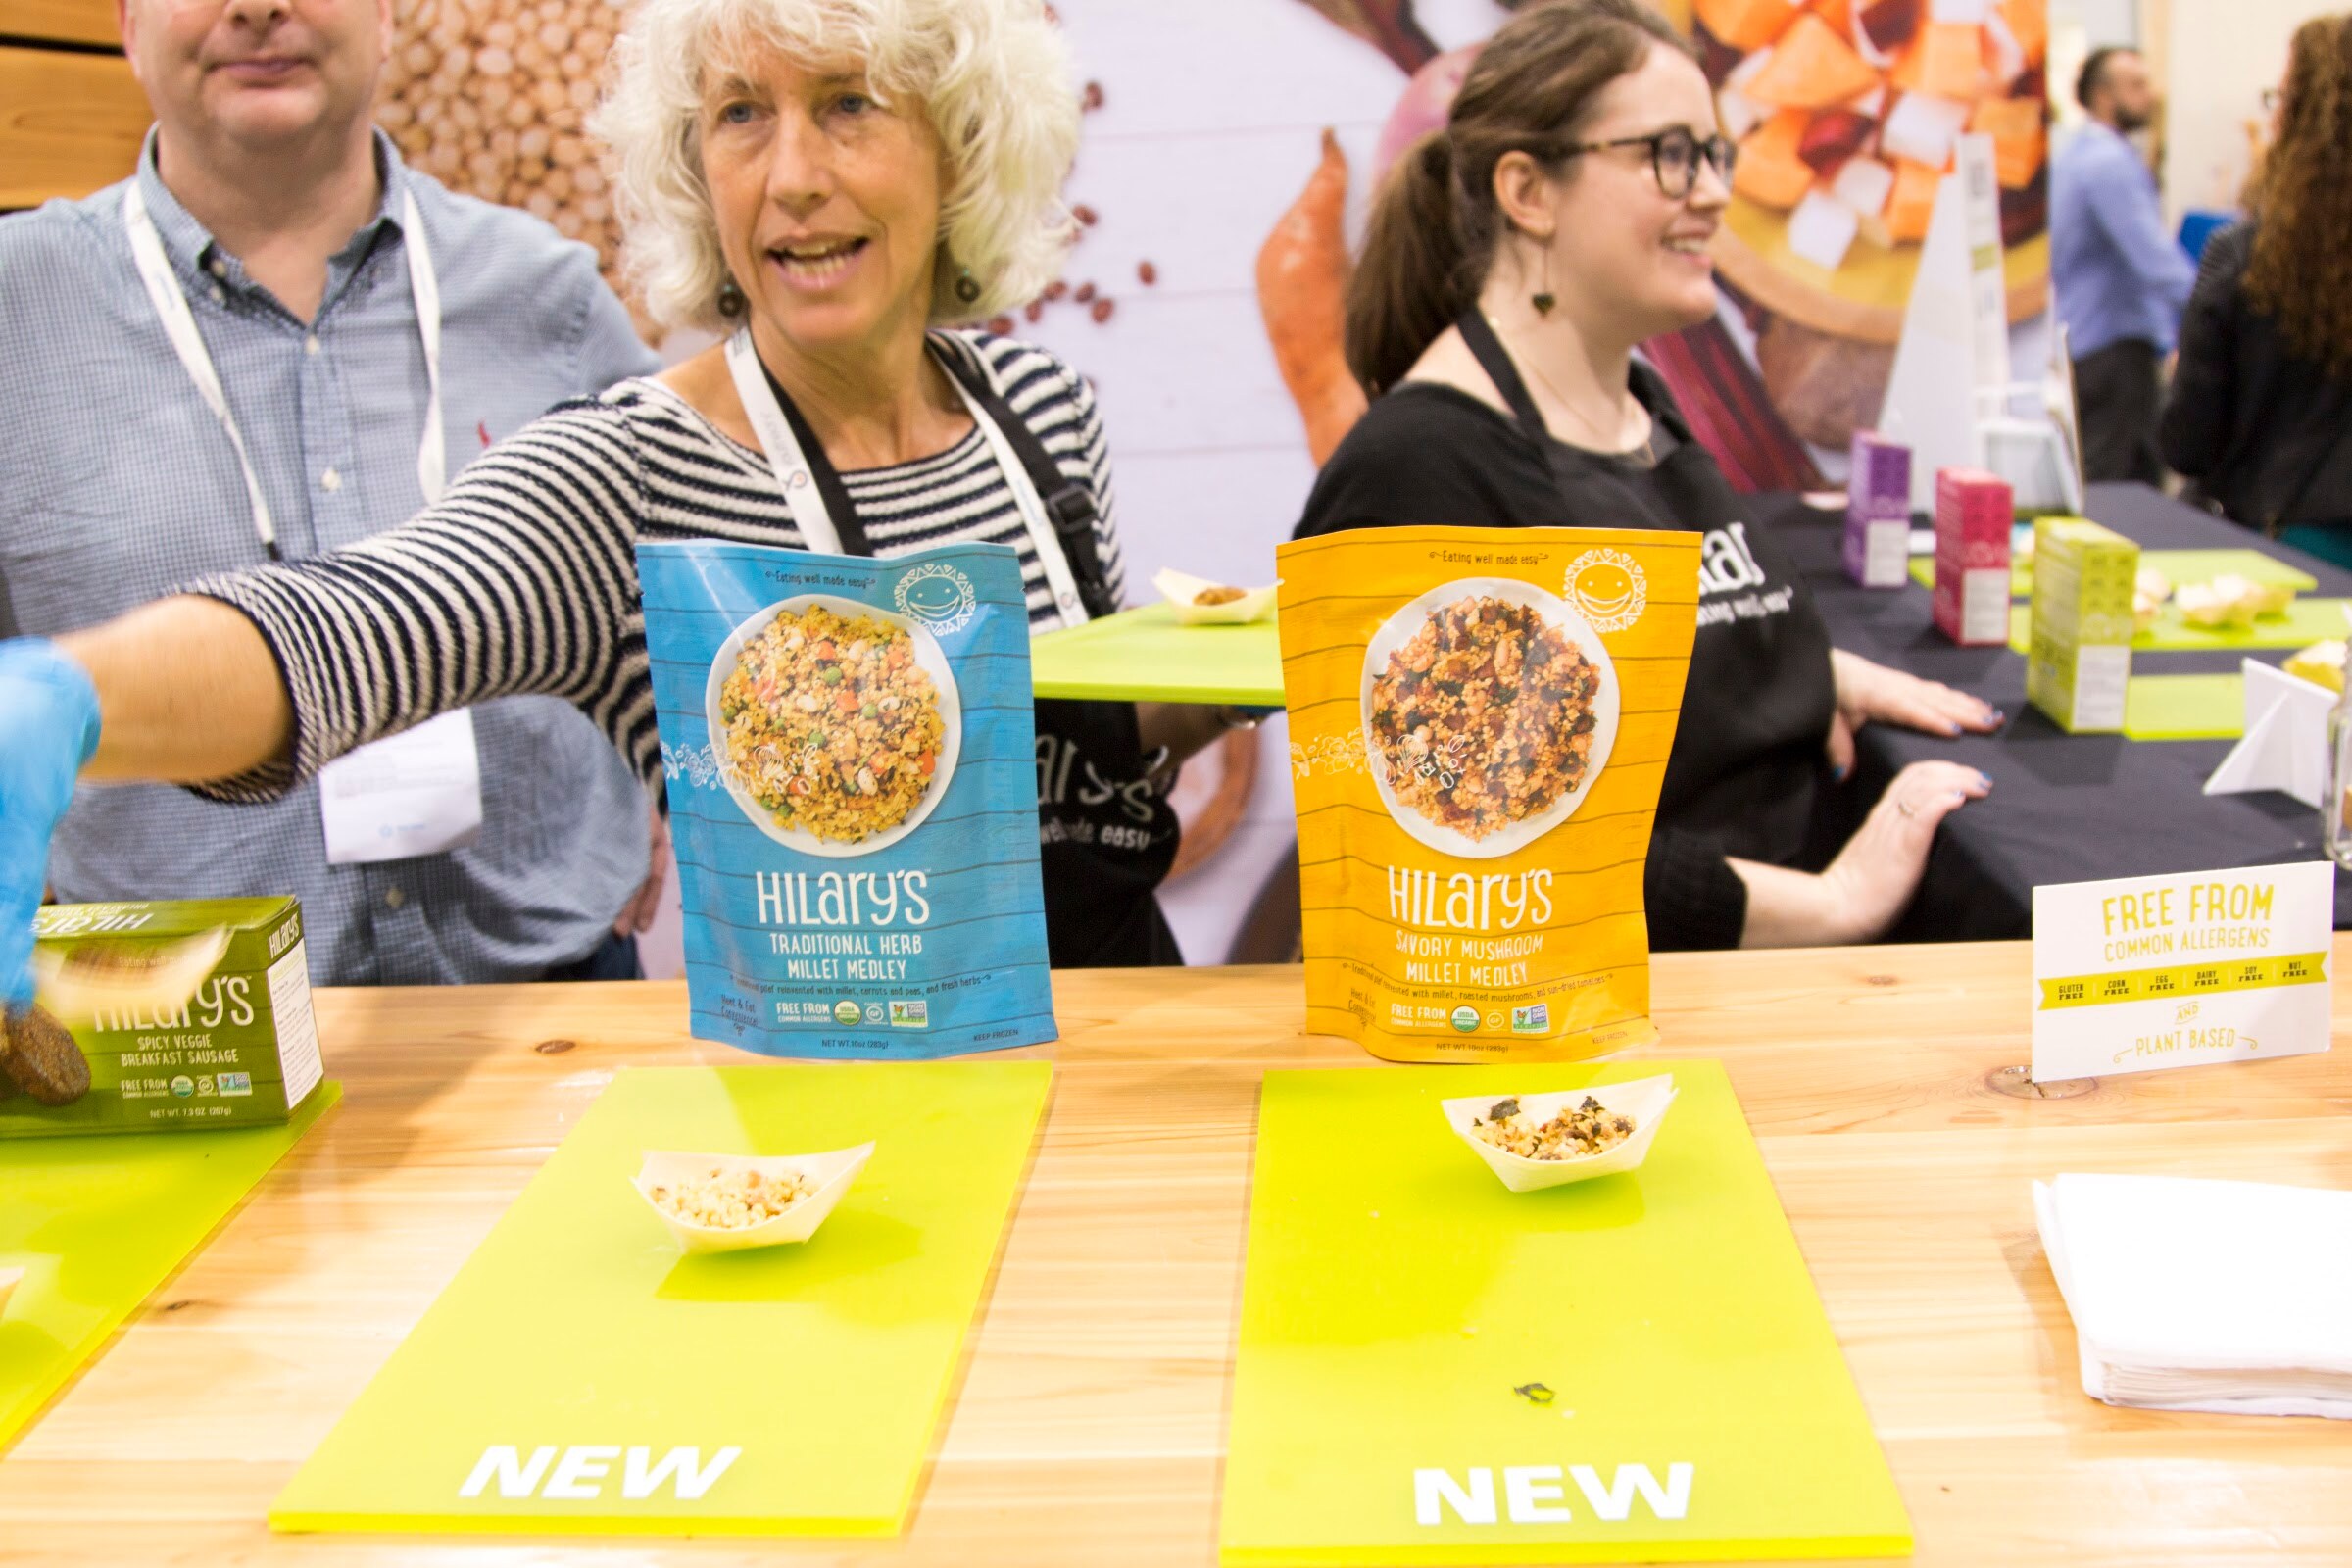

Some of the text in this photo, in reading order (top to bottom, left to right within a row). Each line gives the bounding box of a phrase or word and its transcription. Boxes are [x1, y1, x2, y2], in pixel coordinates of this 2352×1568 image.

[1443, 550, 1538, 565] Eating well made easy
[776, 571, 801, 585] Eating
[805, 573, 820, 584] well
[2102, 883, 2274, 936] FREE FROM
[769, 933, 922, 955] TRADITIONAL HERB
[1396, 929, 1544, 961] SAVORY MUSHROOM
[2104, 927, 2271, 962] COMMON ALLERGENS
[787, 958, 906, 980] MILLET MEDLEY
[1406, 961, 1528, 987] MILLET MEDLEY
[2283, 969, 2308, 978] FREE
[2289, 961, 2301, 970] NUT
[2156, 975, 2169, 984] EGG
[2197, 970, 2217, 980] DAIRY
[817, 986, 833, 995] with
[941, 980, 958, 991] fresh
[960, 976, 981, 986] herbs
[2059, 984, 2083, 994] GLUTEN
[1412, 990, 1429, 999] with
[1432, 990, 1457, 1000] millet,
[1459, 992, 1488, 1001] roasted
[1492, 992, 1536, 1003] mushrooms,
[1537, 987, 1545, 997] and
[776, 1003, 830, 1014] FREE FROM
[1391, 1003, 1414, 1018] FREE
[1417, 1006, 1446, 1020] FROM
[2177, 1004, 2199, 1021] AND
[137, 1034, 213, 1051] SPICY VEGGIE
[973, 1029, 1019, 1042] KEEP FROZEN
[2135, 1027, 2235, 1057] PLANT BASED
[121, 1049, 239, 1067] BREAKFAST SAUSAGE
[121, 1079, 142, 1092] FREE
[143, 1078, 168, 1091] FROM
[457, 1445, 743, 1500] NEW
[1413, 1461, 1695, 1525] NEW
